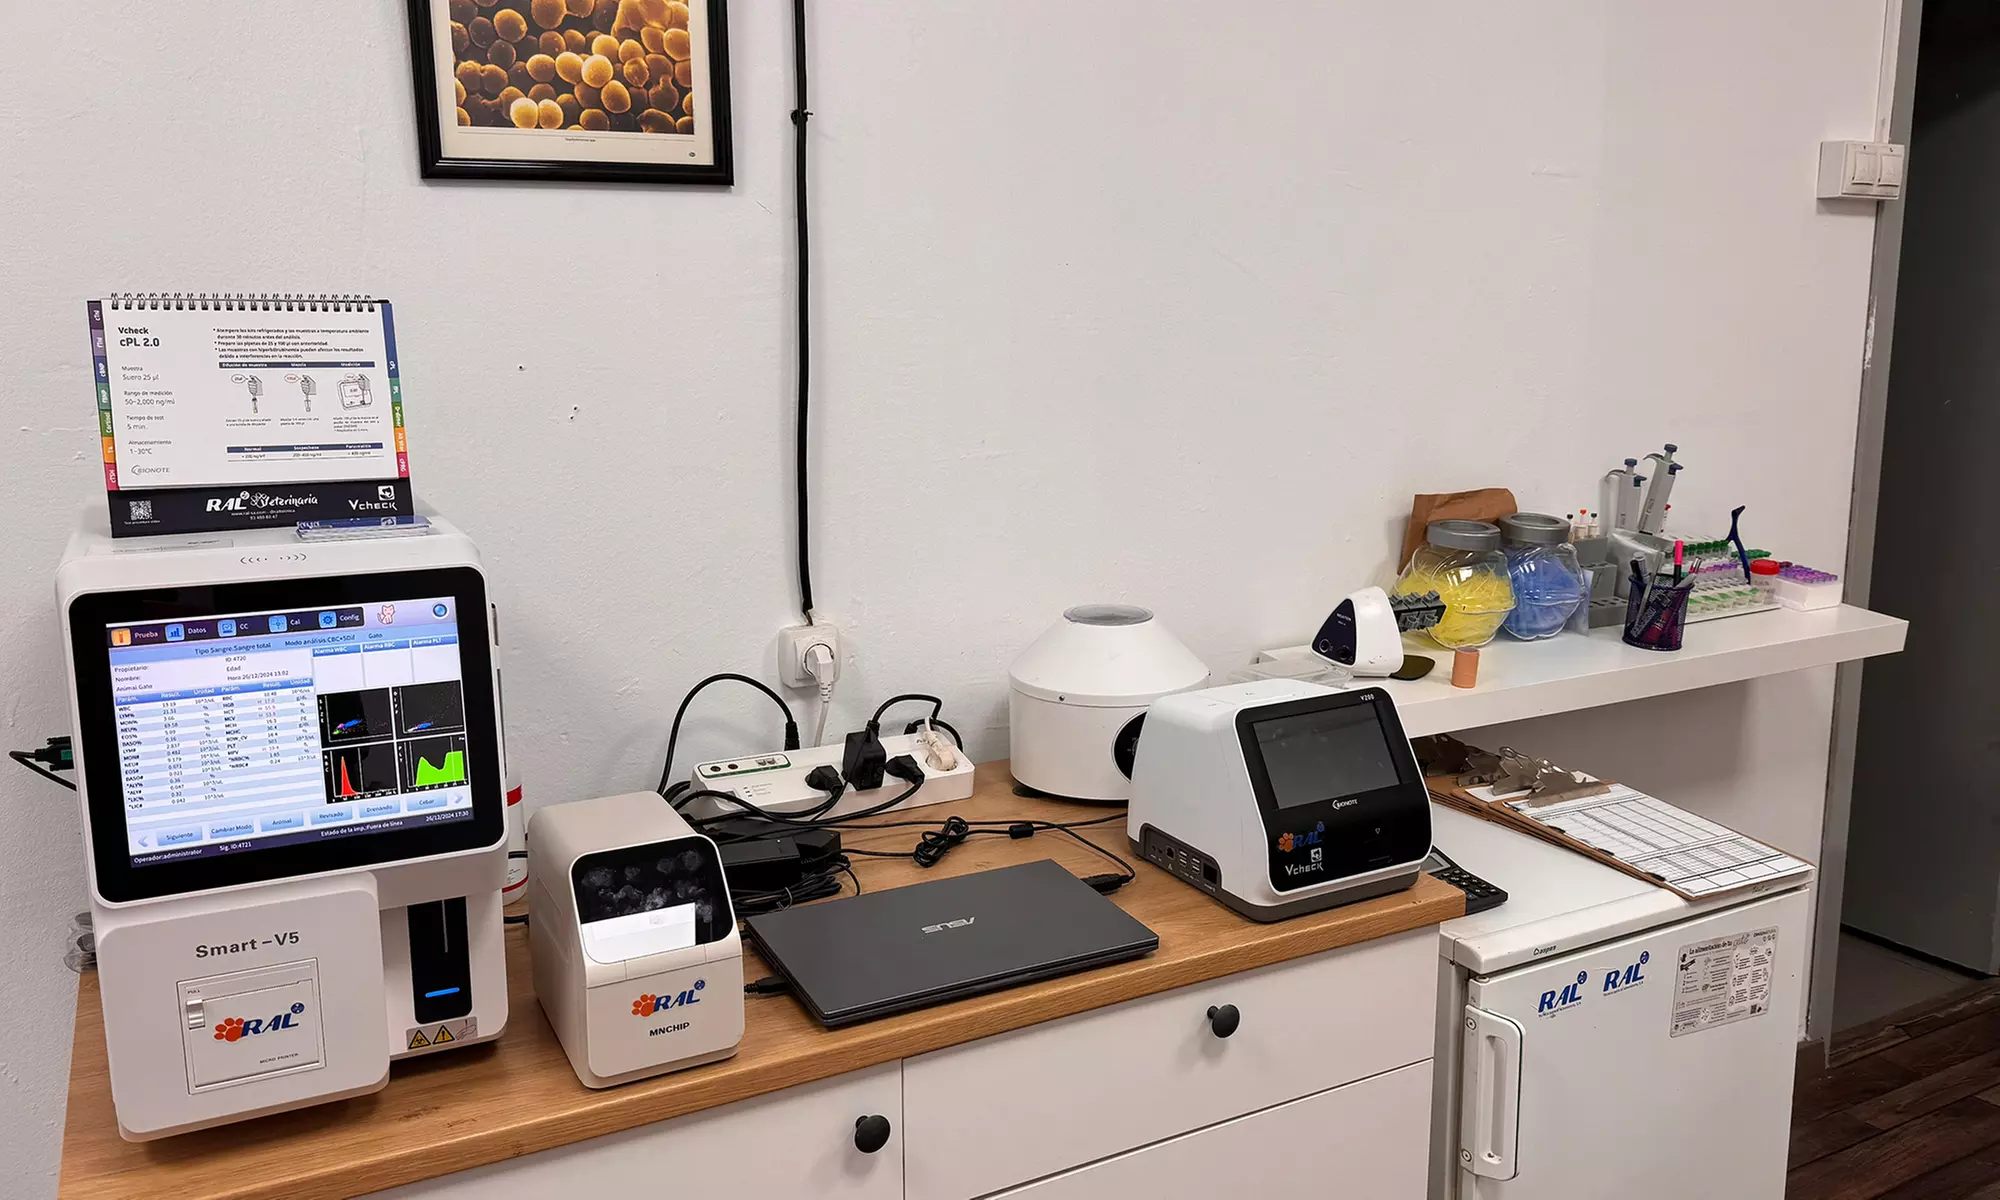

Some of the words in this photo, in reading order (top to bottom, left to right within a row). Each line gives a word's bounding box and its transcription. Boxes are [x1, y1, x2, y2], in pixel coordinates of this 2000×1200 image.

[120, 338, 140, 347] cPL
[143, 338, 160, 347] 2.0
[206, 497, 247, 512] RAL
[166, 832, 193, 841] Siguiente
[1293, 832, 1322, 848] RAL
[922, 917, 975, 934] ASUS
[196, 938, 257, 958] Smart
[1603, 963, 1644, 992] RAL
[654, 990, 700, 1012] RAL
[1538, 983, 1582, 1013] RAL
[241, 1014, 299, 1037] RAL
[649, 1022, 690, 1036] MNCHIP
